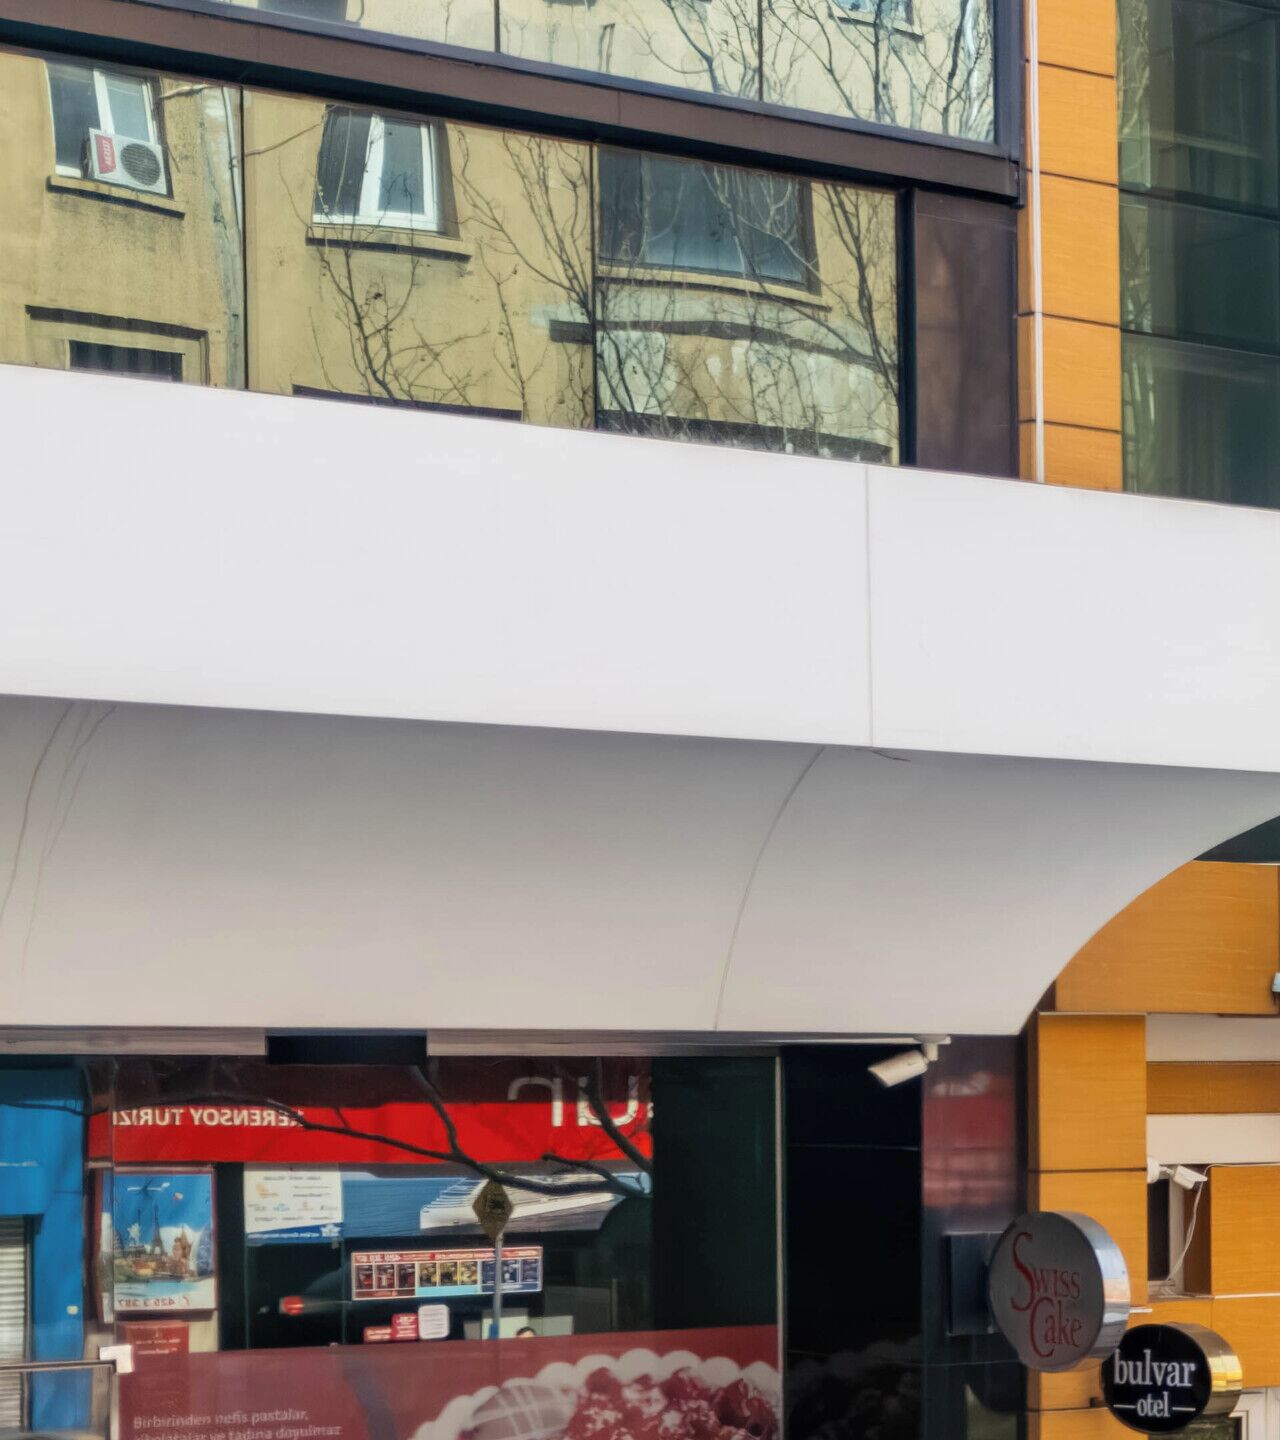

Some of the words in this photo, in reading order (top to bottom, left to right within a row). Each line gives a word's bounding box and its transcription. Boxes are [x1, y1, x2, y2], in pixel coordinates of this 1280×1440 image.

[1030, 1297, 1082, 1357] Cake
[1113, 1349, 1196, 1388] bulvar
[1136, 1392, 1171, 1417] otel
